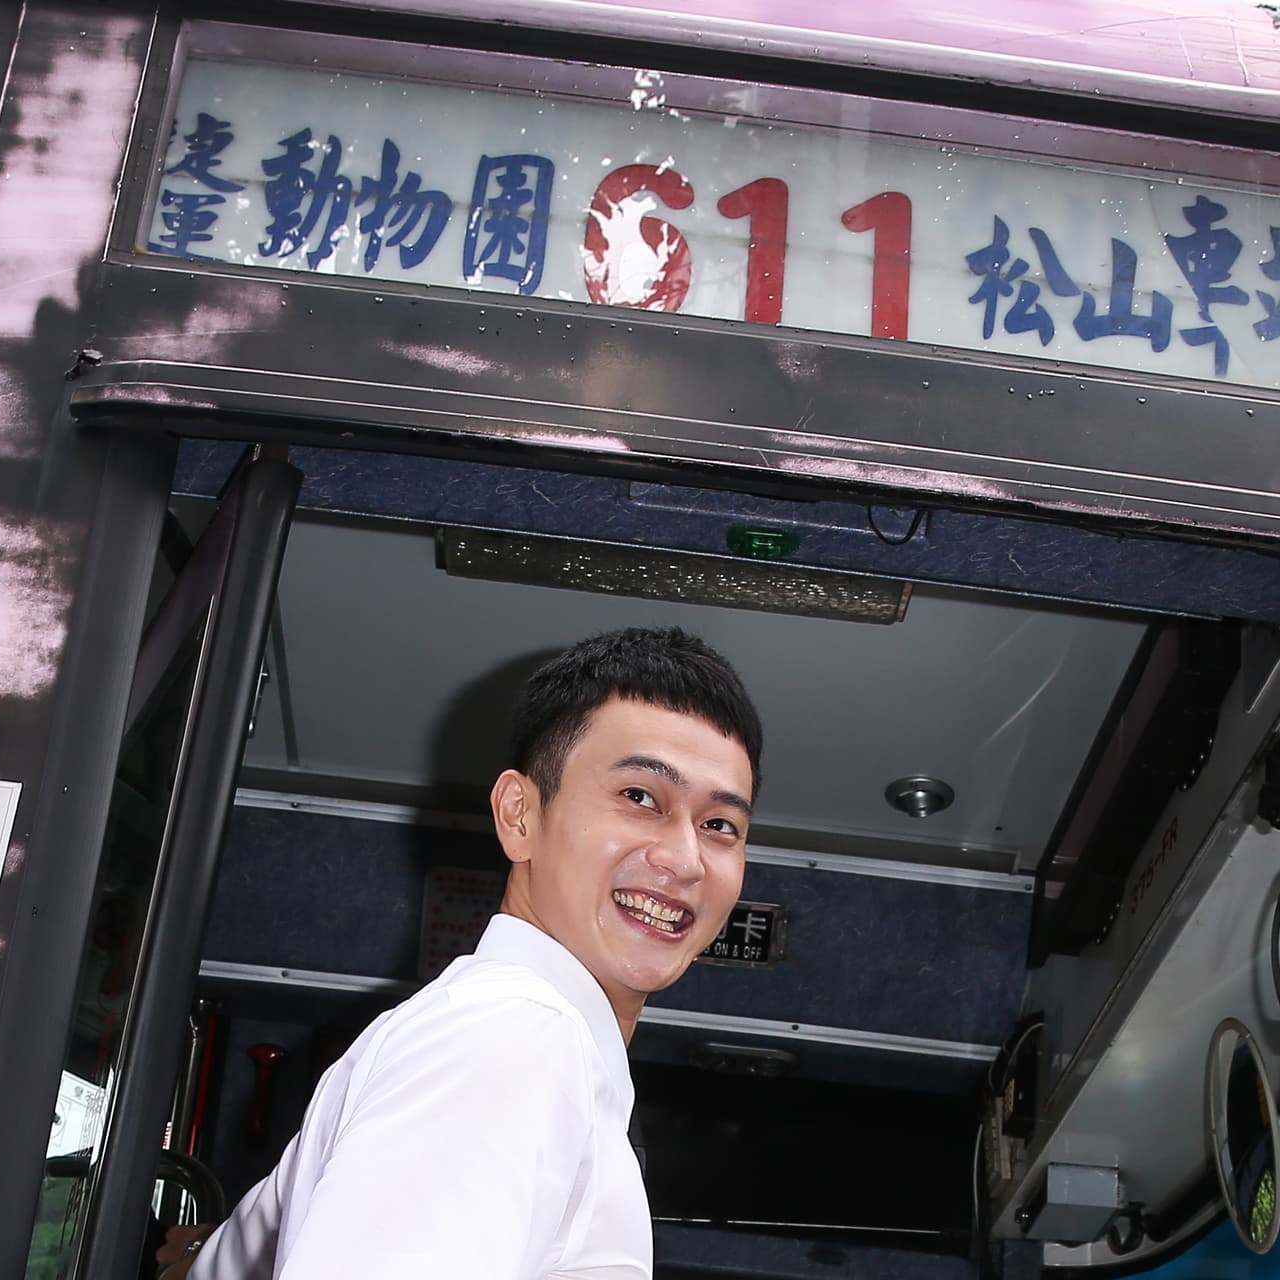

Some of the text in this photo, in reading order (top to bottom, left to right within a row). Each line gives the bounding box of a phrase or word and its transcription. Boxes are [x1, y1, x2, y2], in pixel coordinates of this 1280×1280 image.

[258, 128, 554, 294] 動物園
[584, 164, 914, 340] 611
[718, 913, 766, 943] 卡
[714, 943, 729, 957] ON
[743, 946, 762, 960] OFF
